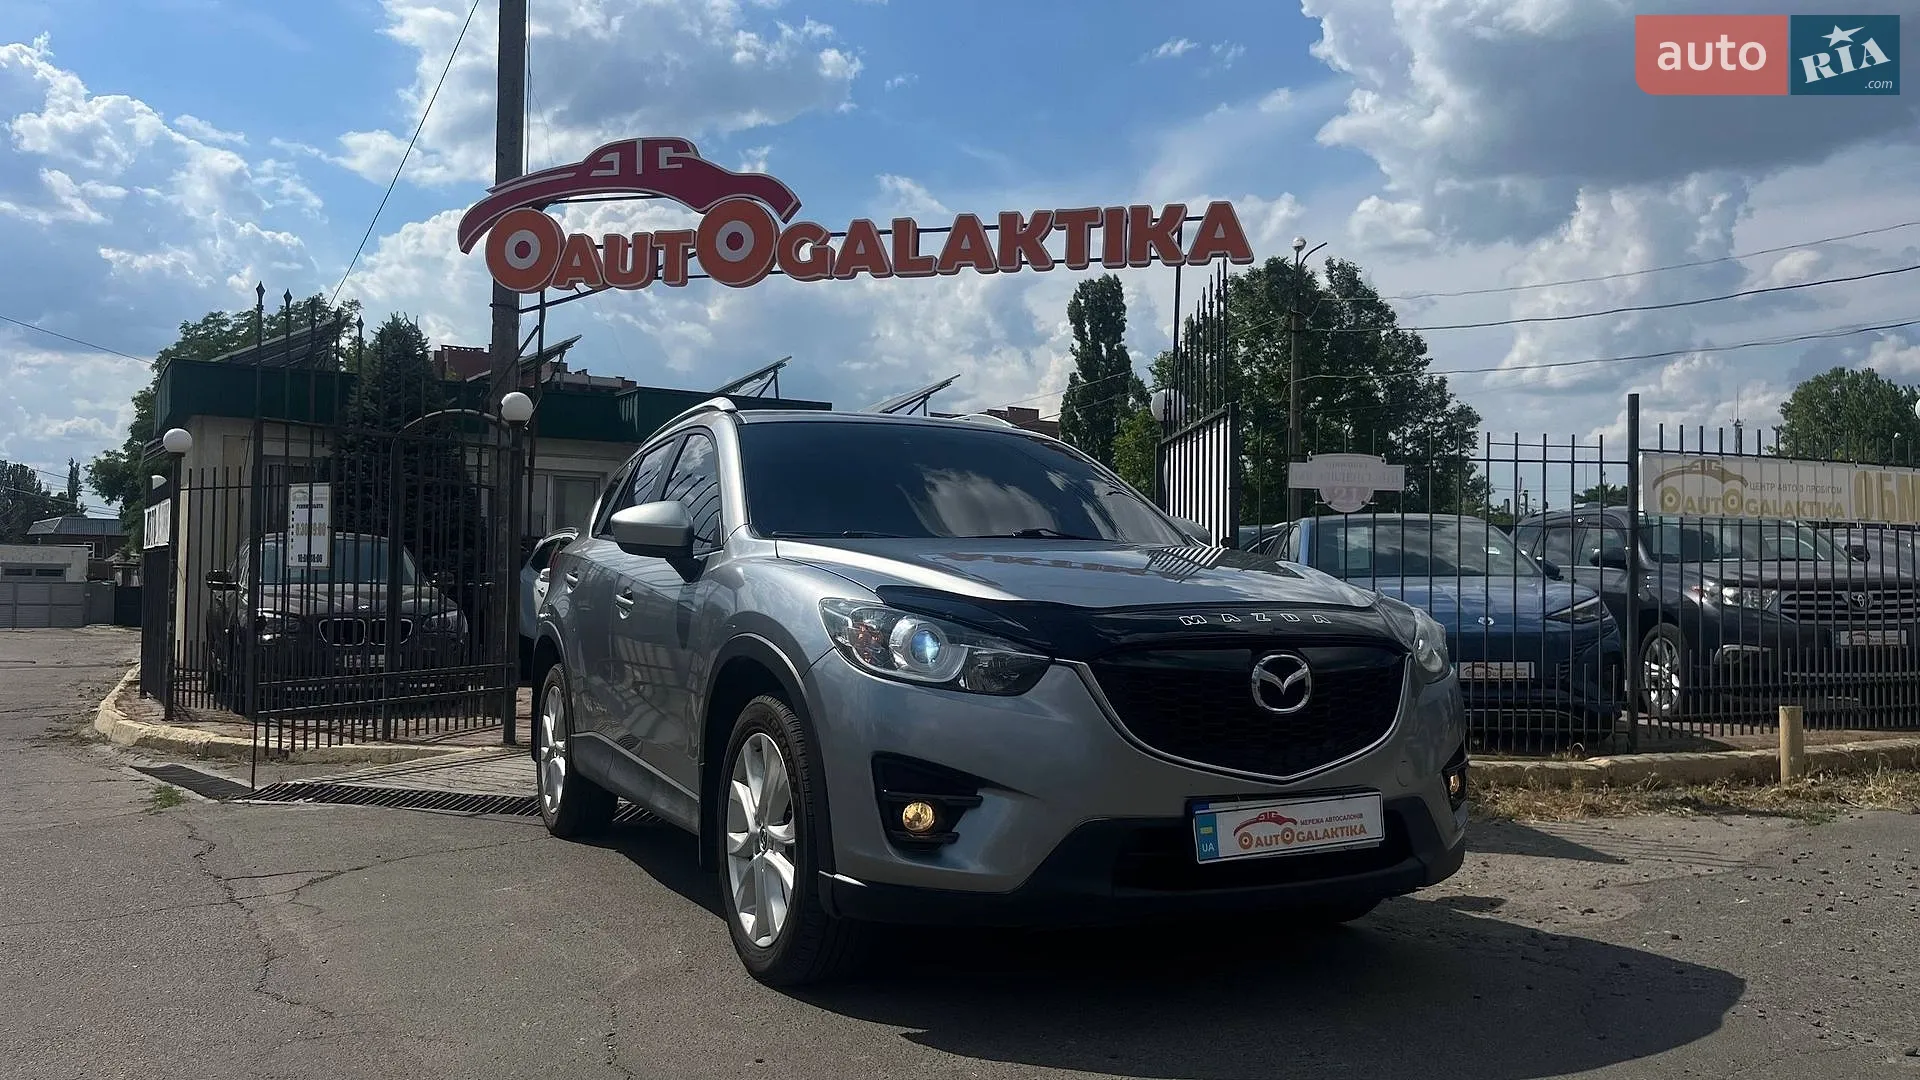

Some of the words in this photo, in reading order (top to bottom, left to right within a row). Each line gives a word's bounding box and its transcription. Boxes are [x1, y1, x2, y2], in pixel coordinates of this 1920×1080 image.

[1749, 481, 1776, 492] ЦЕНТР
[1178, 612, 1332, 626] MAZDA
[1202, 842, 1215, 852] UA
